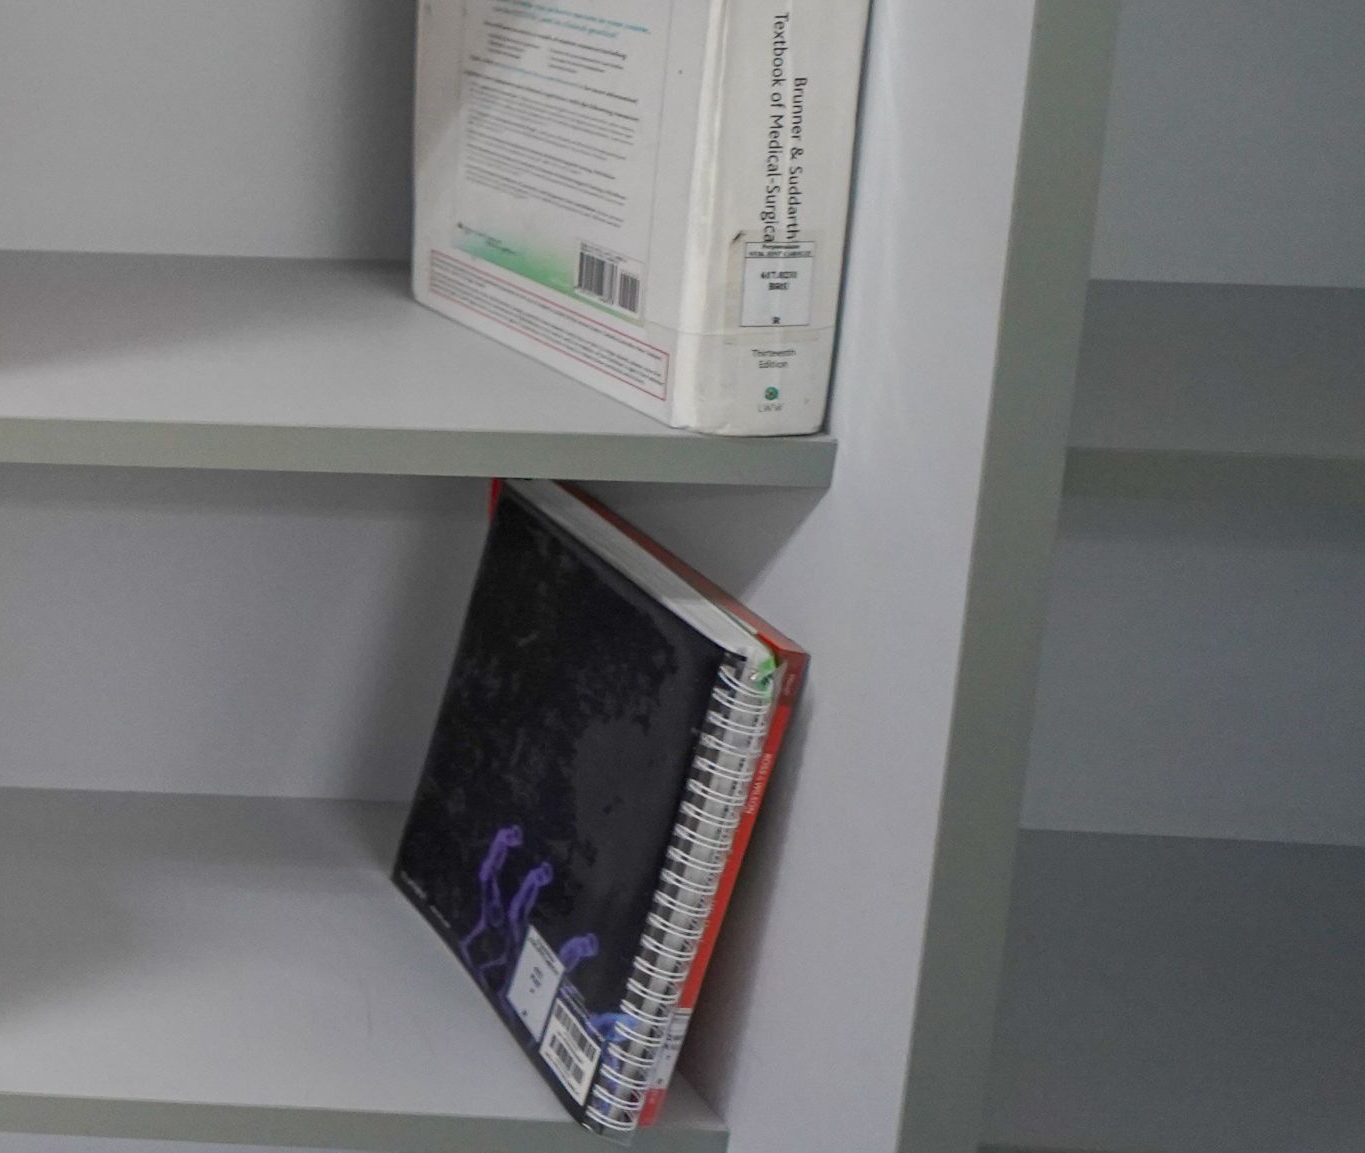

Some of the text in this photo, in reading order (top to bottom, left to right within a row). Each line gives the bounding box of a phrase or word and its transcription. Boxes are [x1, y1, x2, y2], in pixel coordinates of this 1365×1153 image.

[771, 12, 789, 87] Textbook
[770, 92, 786, 110] of
[790, 77, 808, 141] Brunner
[790, 147, 804, 159] &
